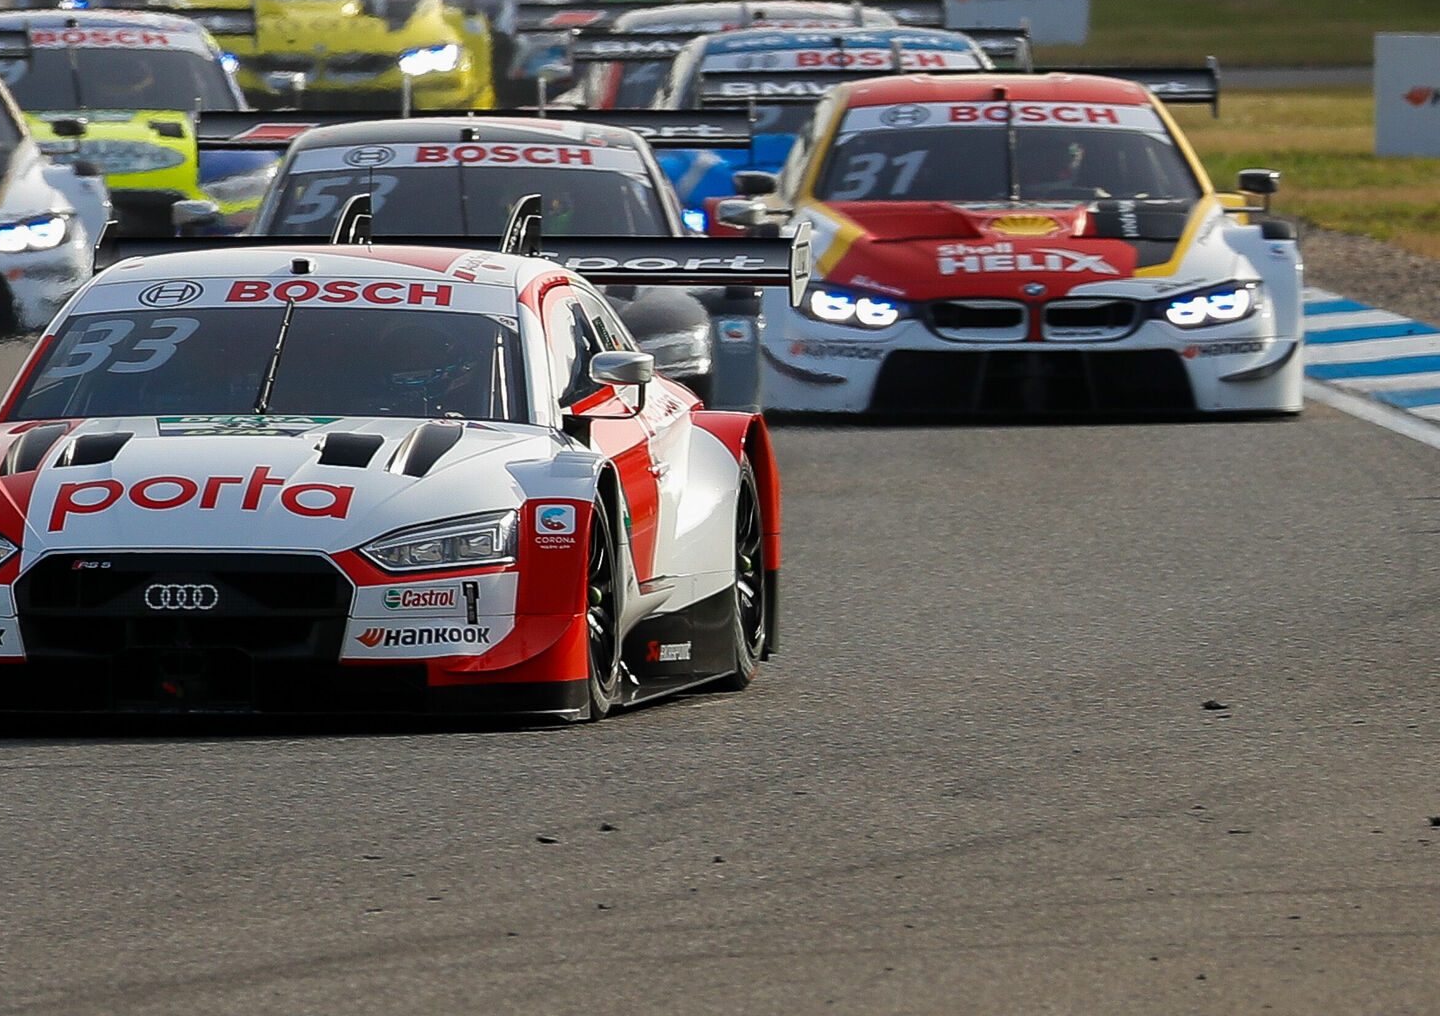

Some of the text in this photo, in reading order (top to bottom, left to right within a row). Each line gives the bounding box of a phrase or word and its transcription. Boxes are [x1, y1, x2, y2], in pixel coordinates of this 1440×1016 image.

[31, 30, 171, 46] BOSCH
[796, 51, 948, 68] BOSCH
[948, 104, 1121, 126] BOSCH
[415, 145, 594, 166] BOSCH
[830, 149, 929, 201] 31
[282, 174, 400, 226] 53
[936, 239, 1015, 260] Shell
[938, 247, 1121, 276] HELIX
[225, 279, 453, 308] BOSCH
[52, 317, 201, 380] 33
[179, 416, 316, 424] DEKRA
[47, 466, 356, 533] porta
[534, 536, 576, 544] CORONA
[401, 588, 455, 607] Castrol
